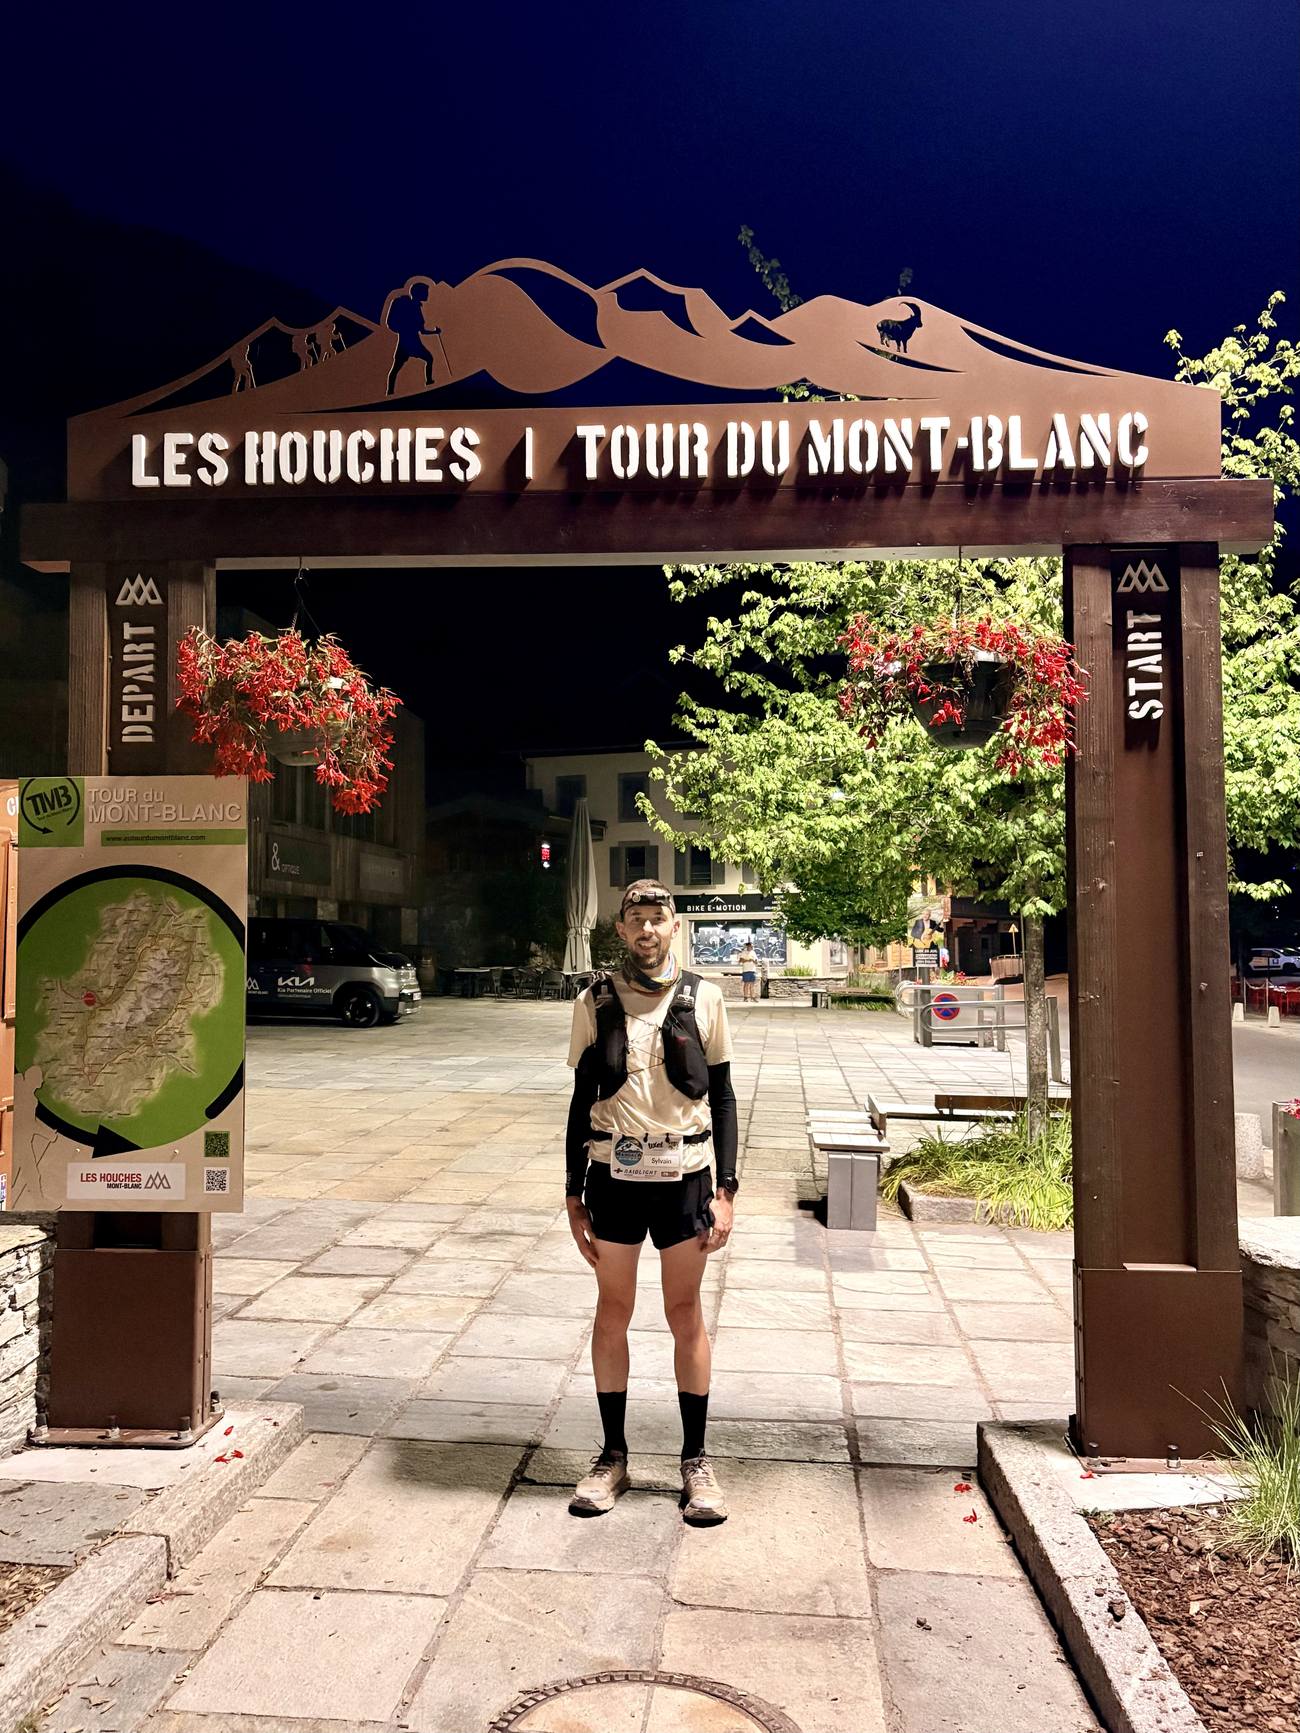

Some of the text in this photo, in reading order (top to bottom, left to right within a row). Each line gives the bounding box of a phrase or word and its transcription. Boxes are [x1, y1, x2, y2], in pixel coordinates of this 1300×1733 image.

[131, 432, 229, 487] LES
[244, 427, 482, 485] HOUCHES
[576, 422, 708, 480] TOUR
[726, 420, 789, 477] DU
[808, 411, 1149, 476] MONT-BLANC
[1127, 609, 1164, 721] START
[121, 622, 155, 743] DEPART
[26, 785, 72, 816] TMB
[88, 788, 164, 803] TOUR du
[88, 803, 242, 823] MONT-BLANC
[80, 1172, 142, 1183] LES HOUCHES
